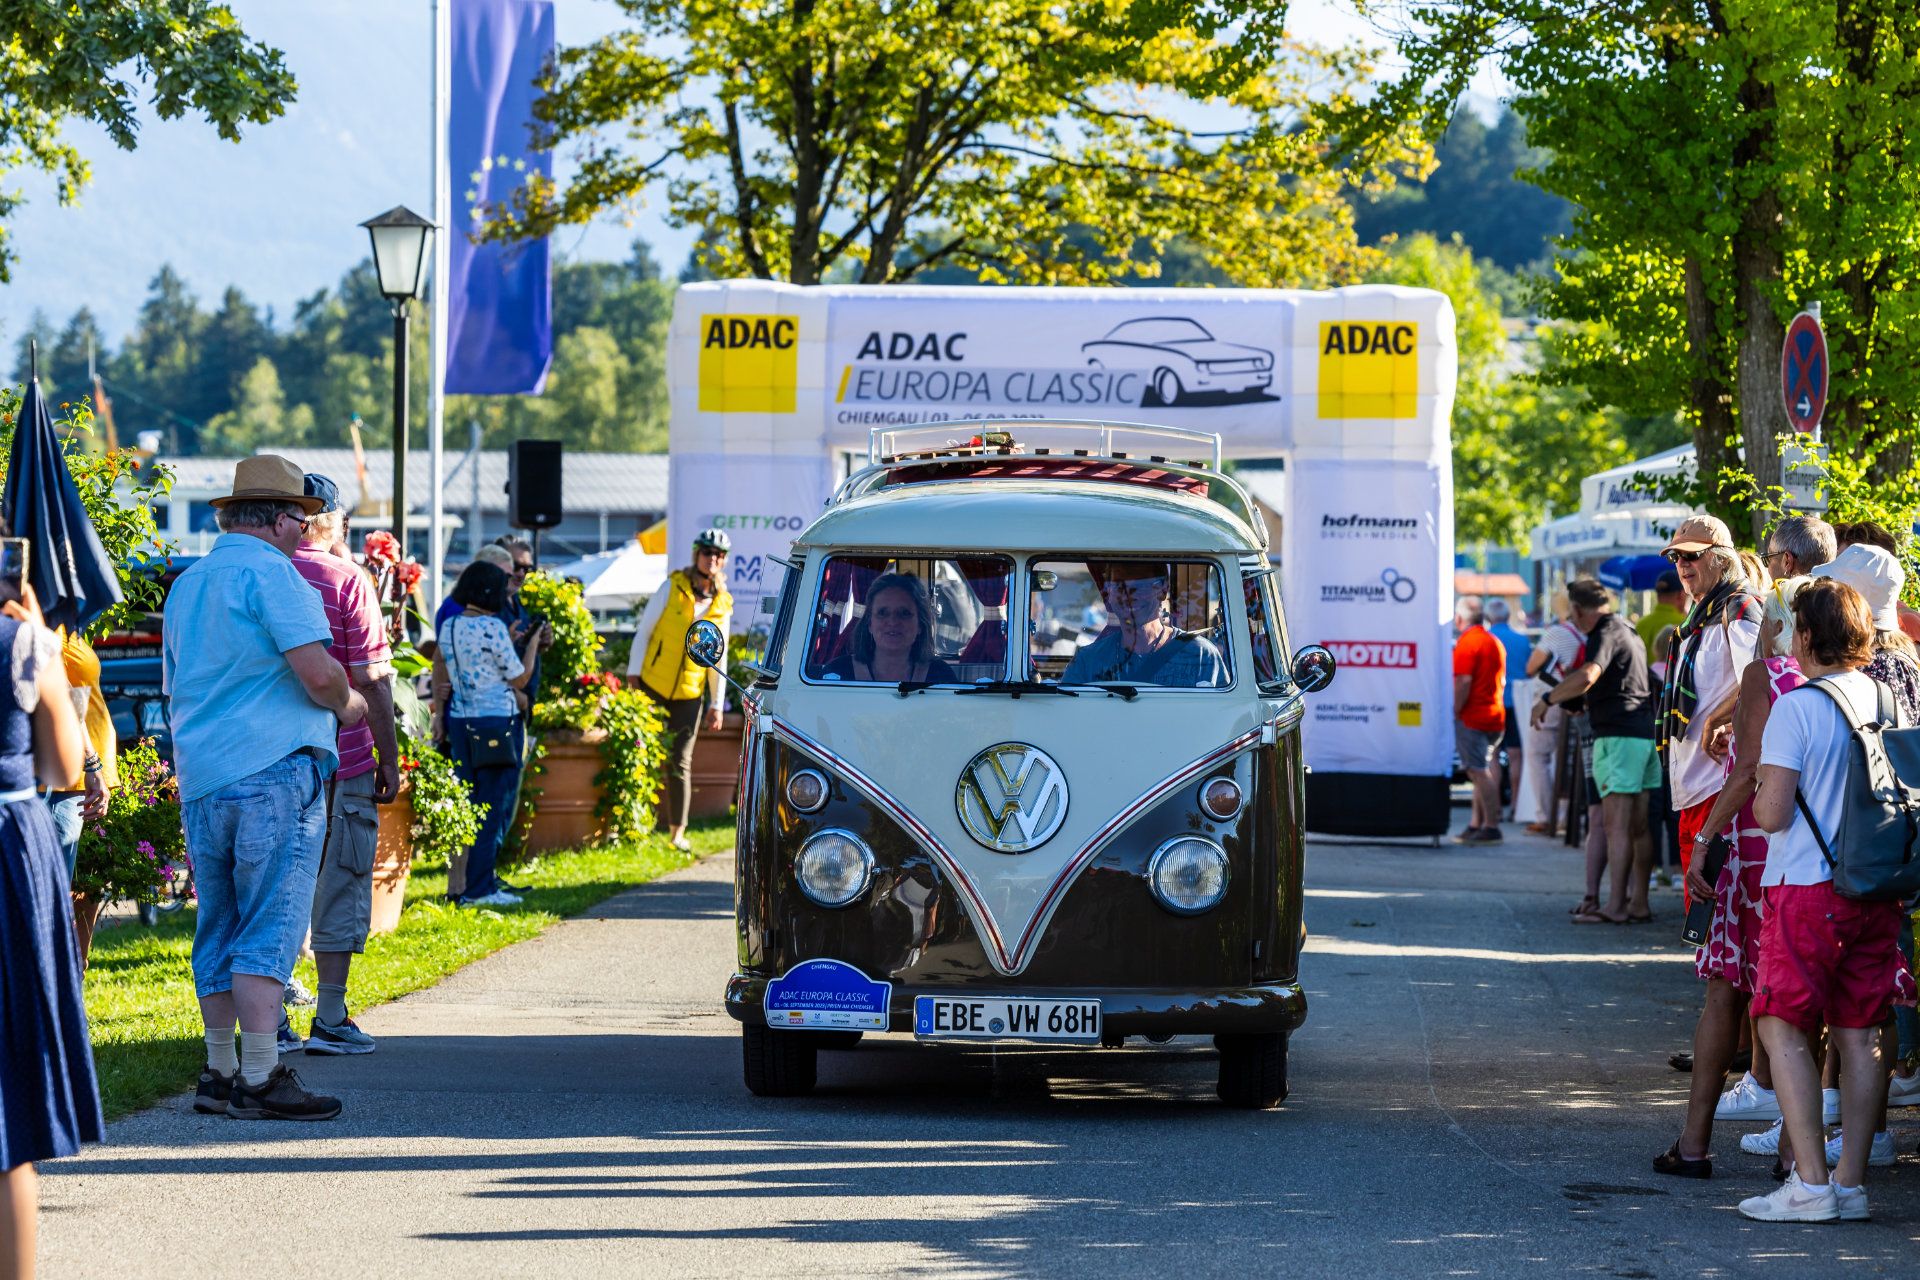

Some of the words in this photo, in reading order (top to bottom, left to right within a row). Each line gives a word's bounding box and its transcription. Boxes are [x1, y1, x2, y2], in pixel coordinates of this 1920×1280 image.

[704, 318, 795, 350] ADAC
[1324, 325, 1414, 355] ADAC
[857, 332, 967, 361] ADAC
[856, 369, 991, 402] EUROPA
[1004, 371, 1139, 404] CLASSIC
[837, 410, 919, 425] CHIEMGAU
[712, 514, 803, 531] GETTYGO
[1322, 514, 1417, 527] hofmann
[1321, 585, 1386, 597] TITANIUM
[1326, 643, 1414, 666] MOTUL
[811, 963, 838, 971] CHIEMGAU
[779, 991, 799, 1000] ADAC
[800, 991, 833, 1000] EUROPA
[836, 992, 871, 1002] CLASSIC
[921, 1019, 929, 1028] D
[934, 1002, 985, 1031] EBE
[1007, 1004, 1040, 1032] VW
[1048, 1005, 1097, 1033] 68H
